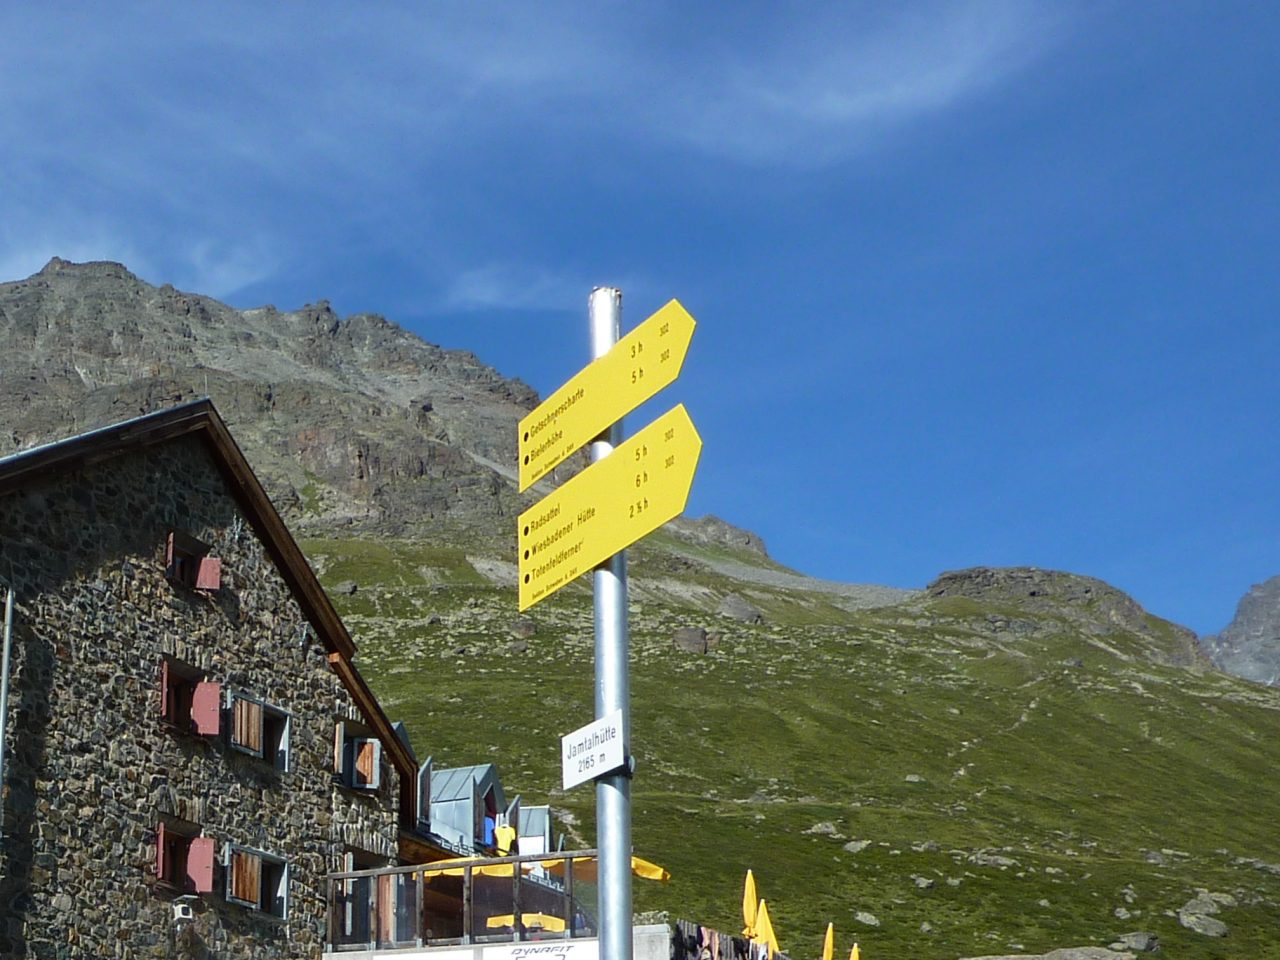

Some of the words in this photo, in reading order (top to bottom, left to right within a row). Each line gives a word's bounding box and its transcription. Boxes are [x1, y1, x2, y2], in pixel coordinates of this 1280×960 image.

[631, 344, 637, 358] 3
[638, 341, 643, 354] h
[659, 322, 669, 337] 302
[530, 430, 563, 462] Bielerhöhe
[631, 370, 637, 384] 5
[639, 367, 644, 379] h
[660, 348, 670, 363] 302
[530, 503, 561, 533] Radsattel
[635, 447, 641, 461] 5
[643, 444, 648, 457] h
[664, 428, 674, 442] 302
[531, 522, 574, 556] Wiesbadener
[577, 507, 596, 527] Hütte
[635, 474, 641, 488] 6
[643, 471, 648, 484] h
[664, 454, 674, 469] 302
[531, 542, 582, 580] Totenfeldferner
[629, 504, 635, 519] 2
[643, 497, 649, 510] h
[567, 726, 616, 760] Jamtalhütte
[578, 755, 595, 773] 2165
[599, 753, 606, 763] m
[511, 945, 575, 955] DYNAFIT
